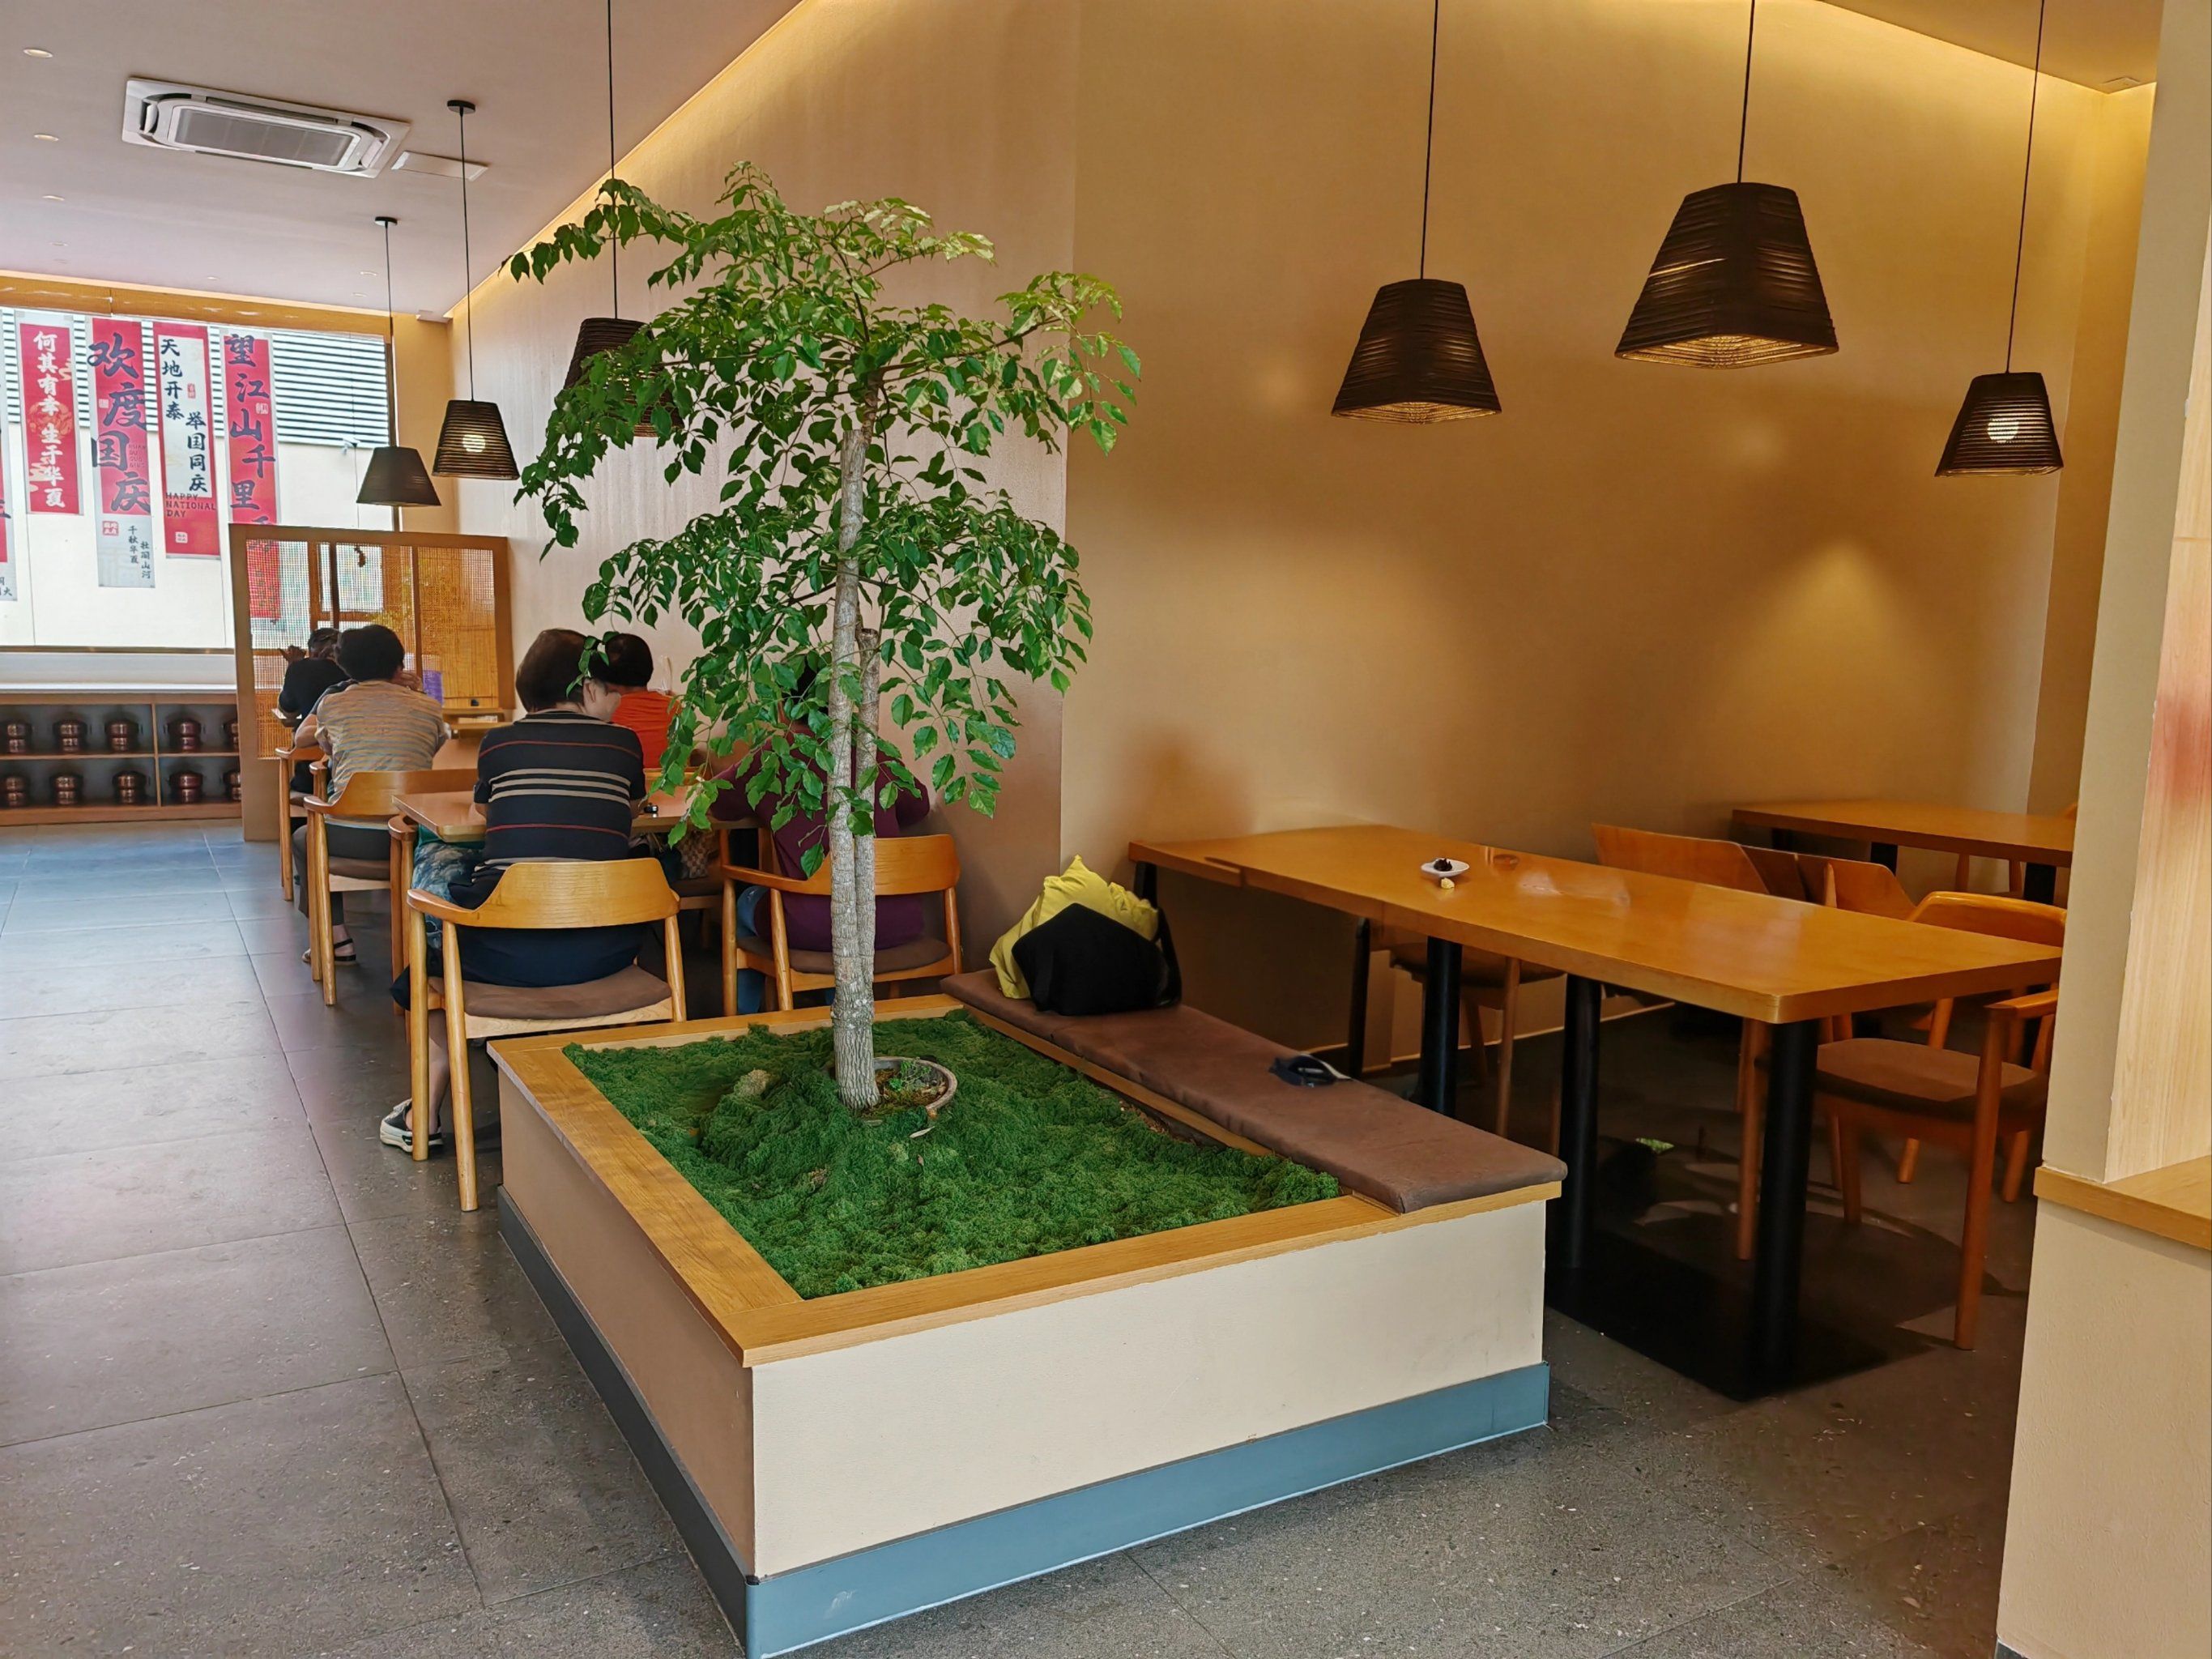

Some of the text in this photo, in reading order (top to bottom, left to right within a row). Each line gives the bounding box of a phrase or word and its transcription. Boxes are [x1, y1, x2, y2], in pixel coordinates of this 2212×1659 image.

[33, 331, 65, 508] 何其有幸生于华夏
[160, 339, 185, 420] 天地开泰
[87, 332, 151, 514] 欢度国庆
[185, 411, 208, 493] 举国同庆
[224, 334, 276, 524] 望江山千里
[165, 493, 198, 501] HAPPY
[165, 501, 216, 510] NATIONAL
[167, 510, 185, 518] DAY
[128, 525, 139, 564] 千秋华夏
